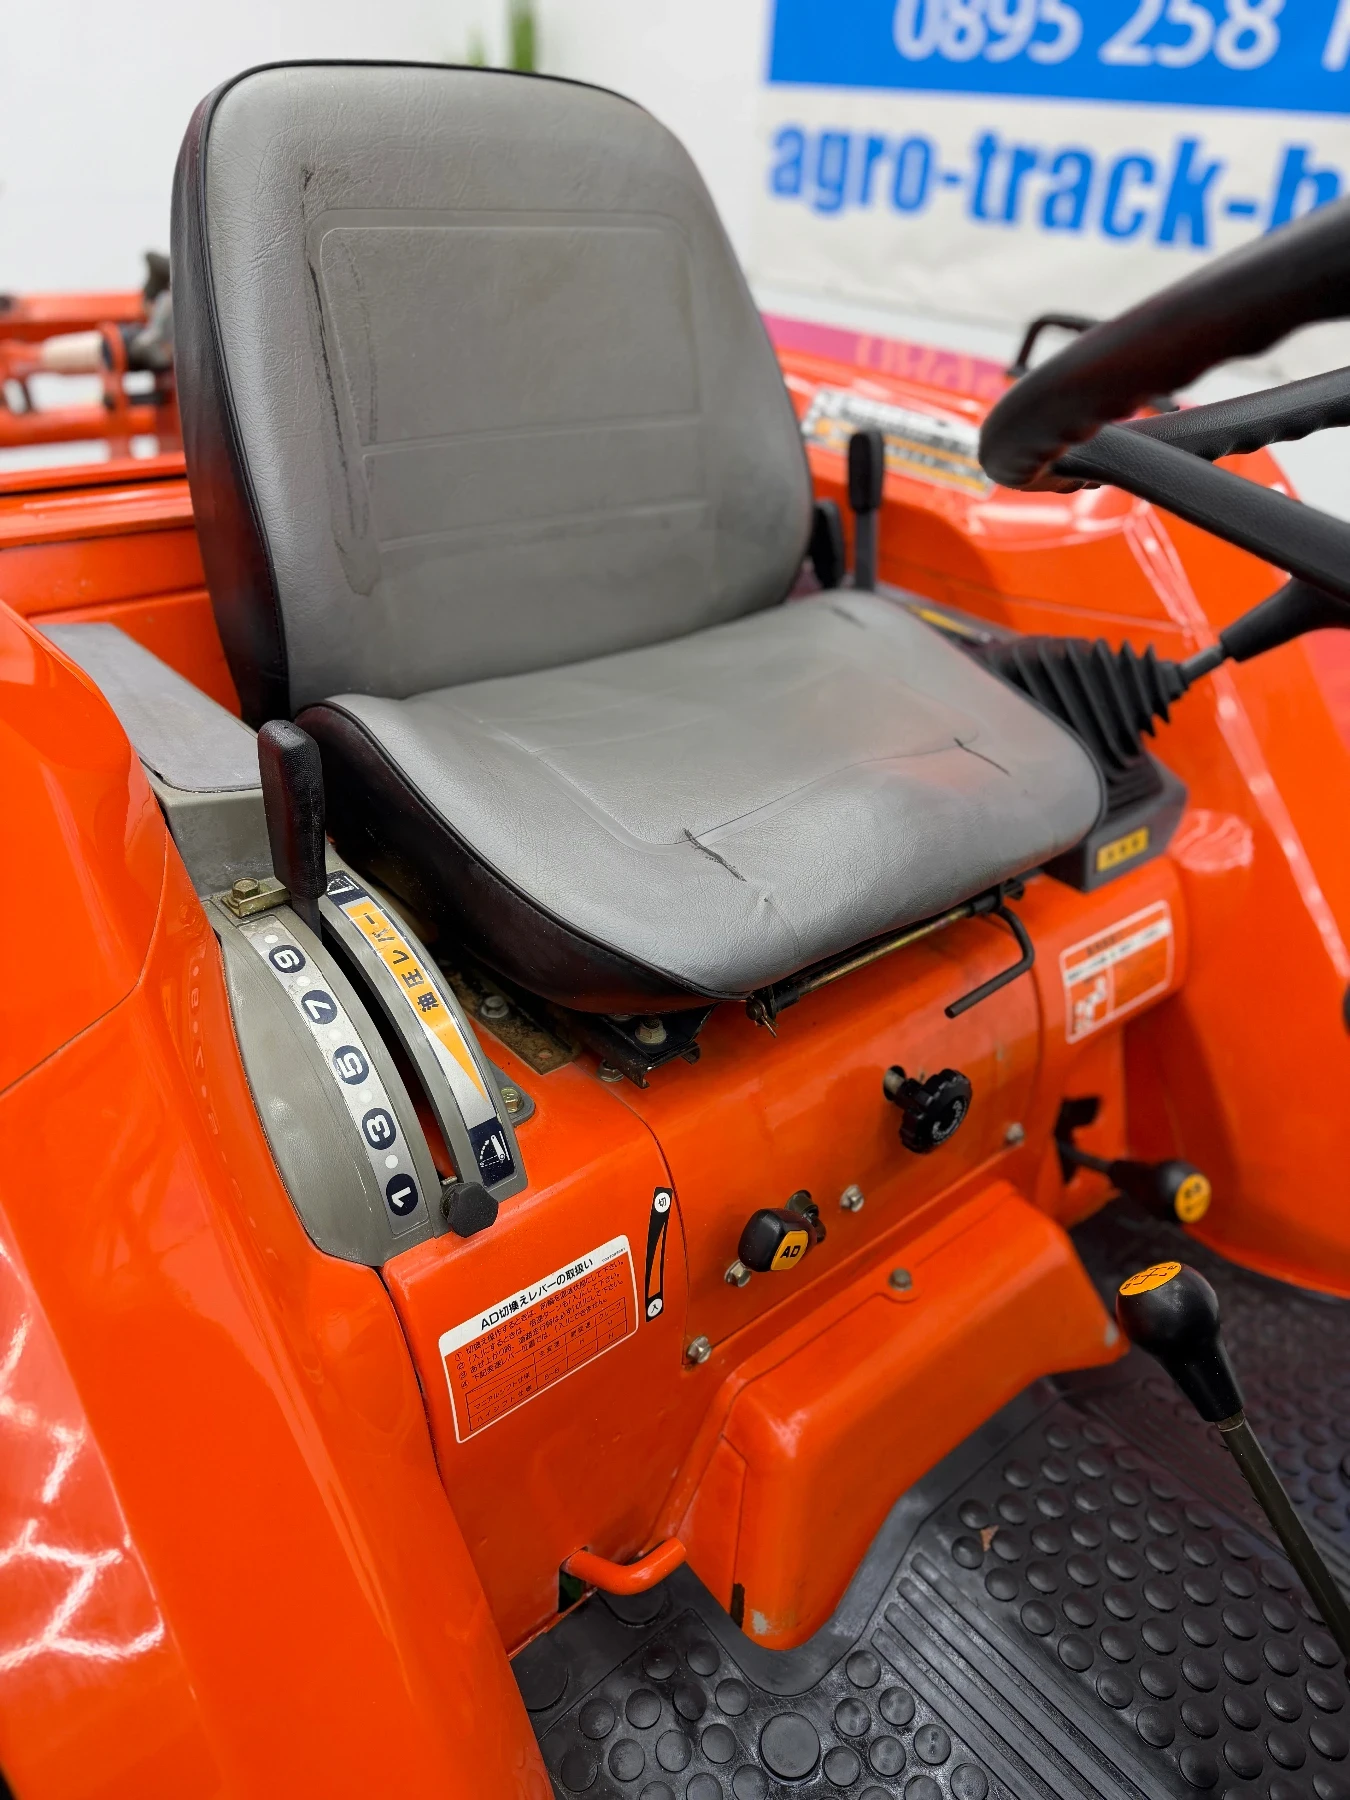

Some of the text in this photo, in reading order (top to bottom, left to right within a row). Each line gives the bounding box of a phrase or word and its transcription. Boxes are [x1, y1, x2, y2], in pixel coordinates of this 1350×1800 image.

[892, 0, 1083, 65] 0895
[1098, 0, 1281, 70] 258
[304, 999, 332, 1020] 7
[336, 1052, 363, 1079] 5
[366, 1114, 391, 1142] 3
[391, 1186, 412, 1208] 1
[779, 1244, 801, 1259] AD
[480, 1257, 594, 1331] AD切換えレバーの取扱い
